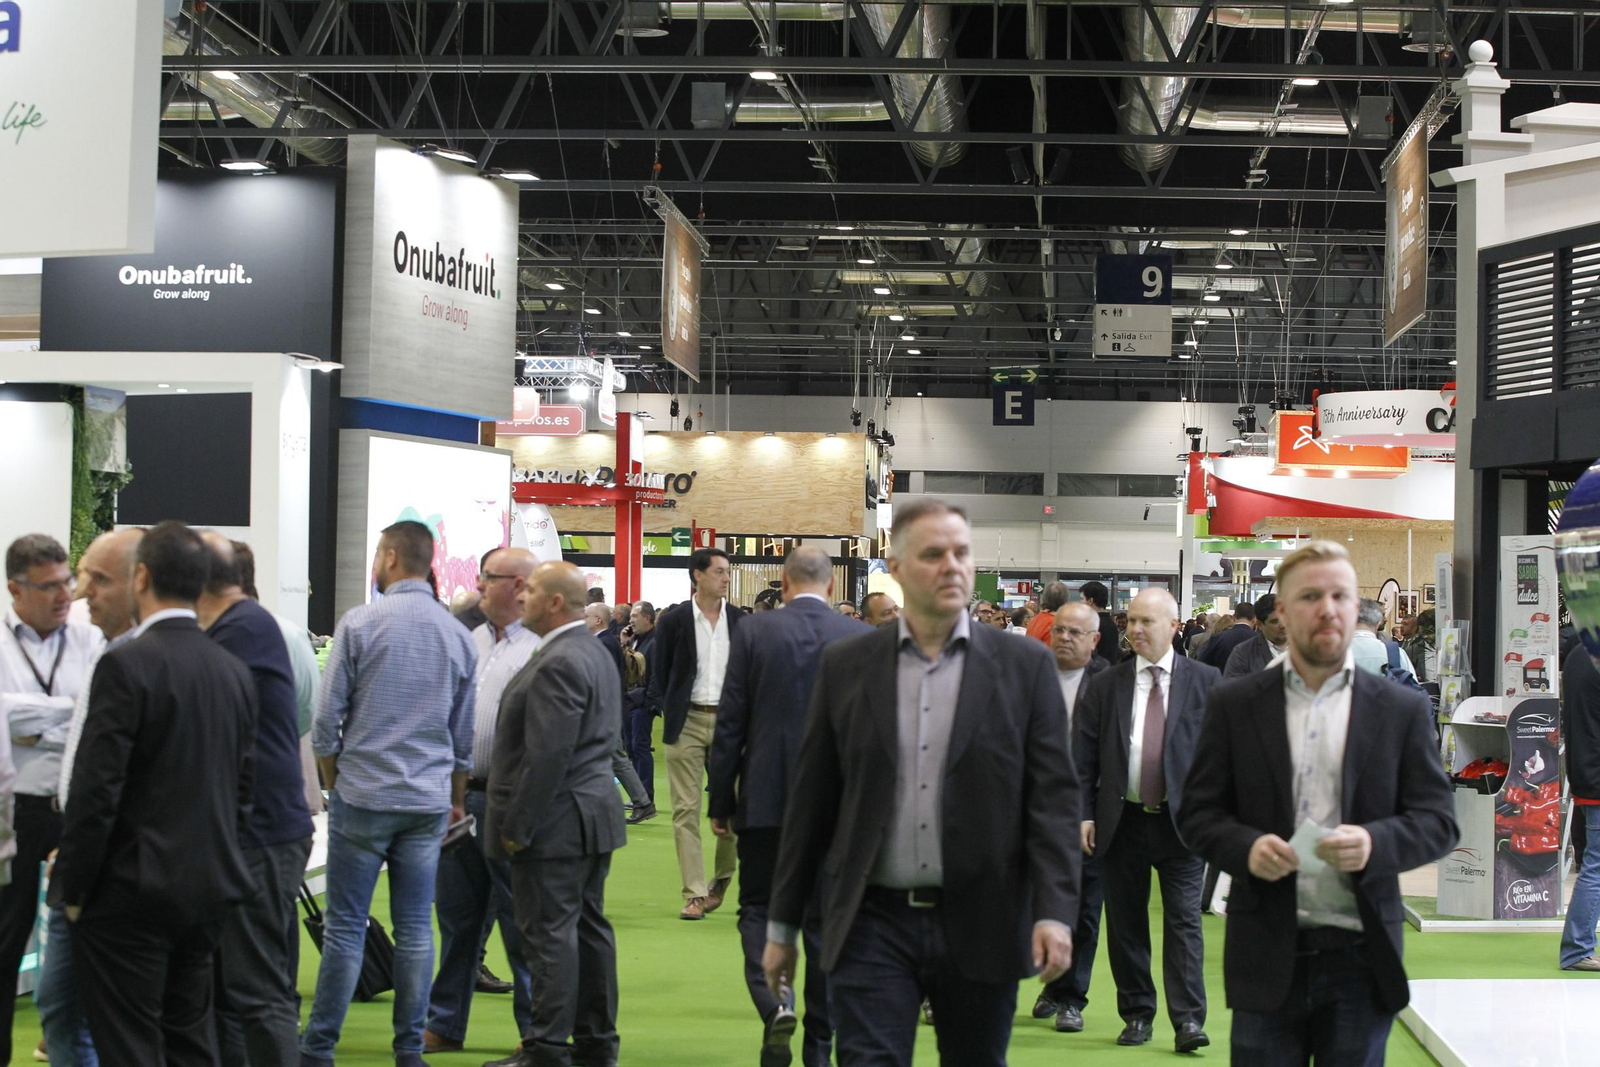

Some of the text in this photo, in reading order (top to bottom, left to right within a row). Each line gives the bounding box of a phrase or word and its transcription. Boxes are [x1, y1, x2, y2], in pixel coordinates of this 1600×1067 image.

[2, 101, 48, 145] life
[119, 263, 253, 285] Onubafruit.
[394, 231, 501, 300] Onubafruit.
[153, 288, 210, 301] Grow along
[1142, 266, 1163, 297] 9
[422, 295, 469, 331] Grow along
[1005, 391, 1022, 419] E
[1337, 405, 1407, 426] Anniversary
[1513, 890, 1549, 904] VITAMINA C
